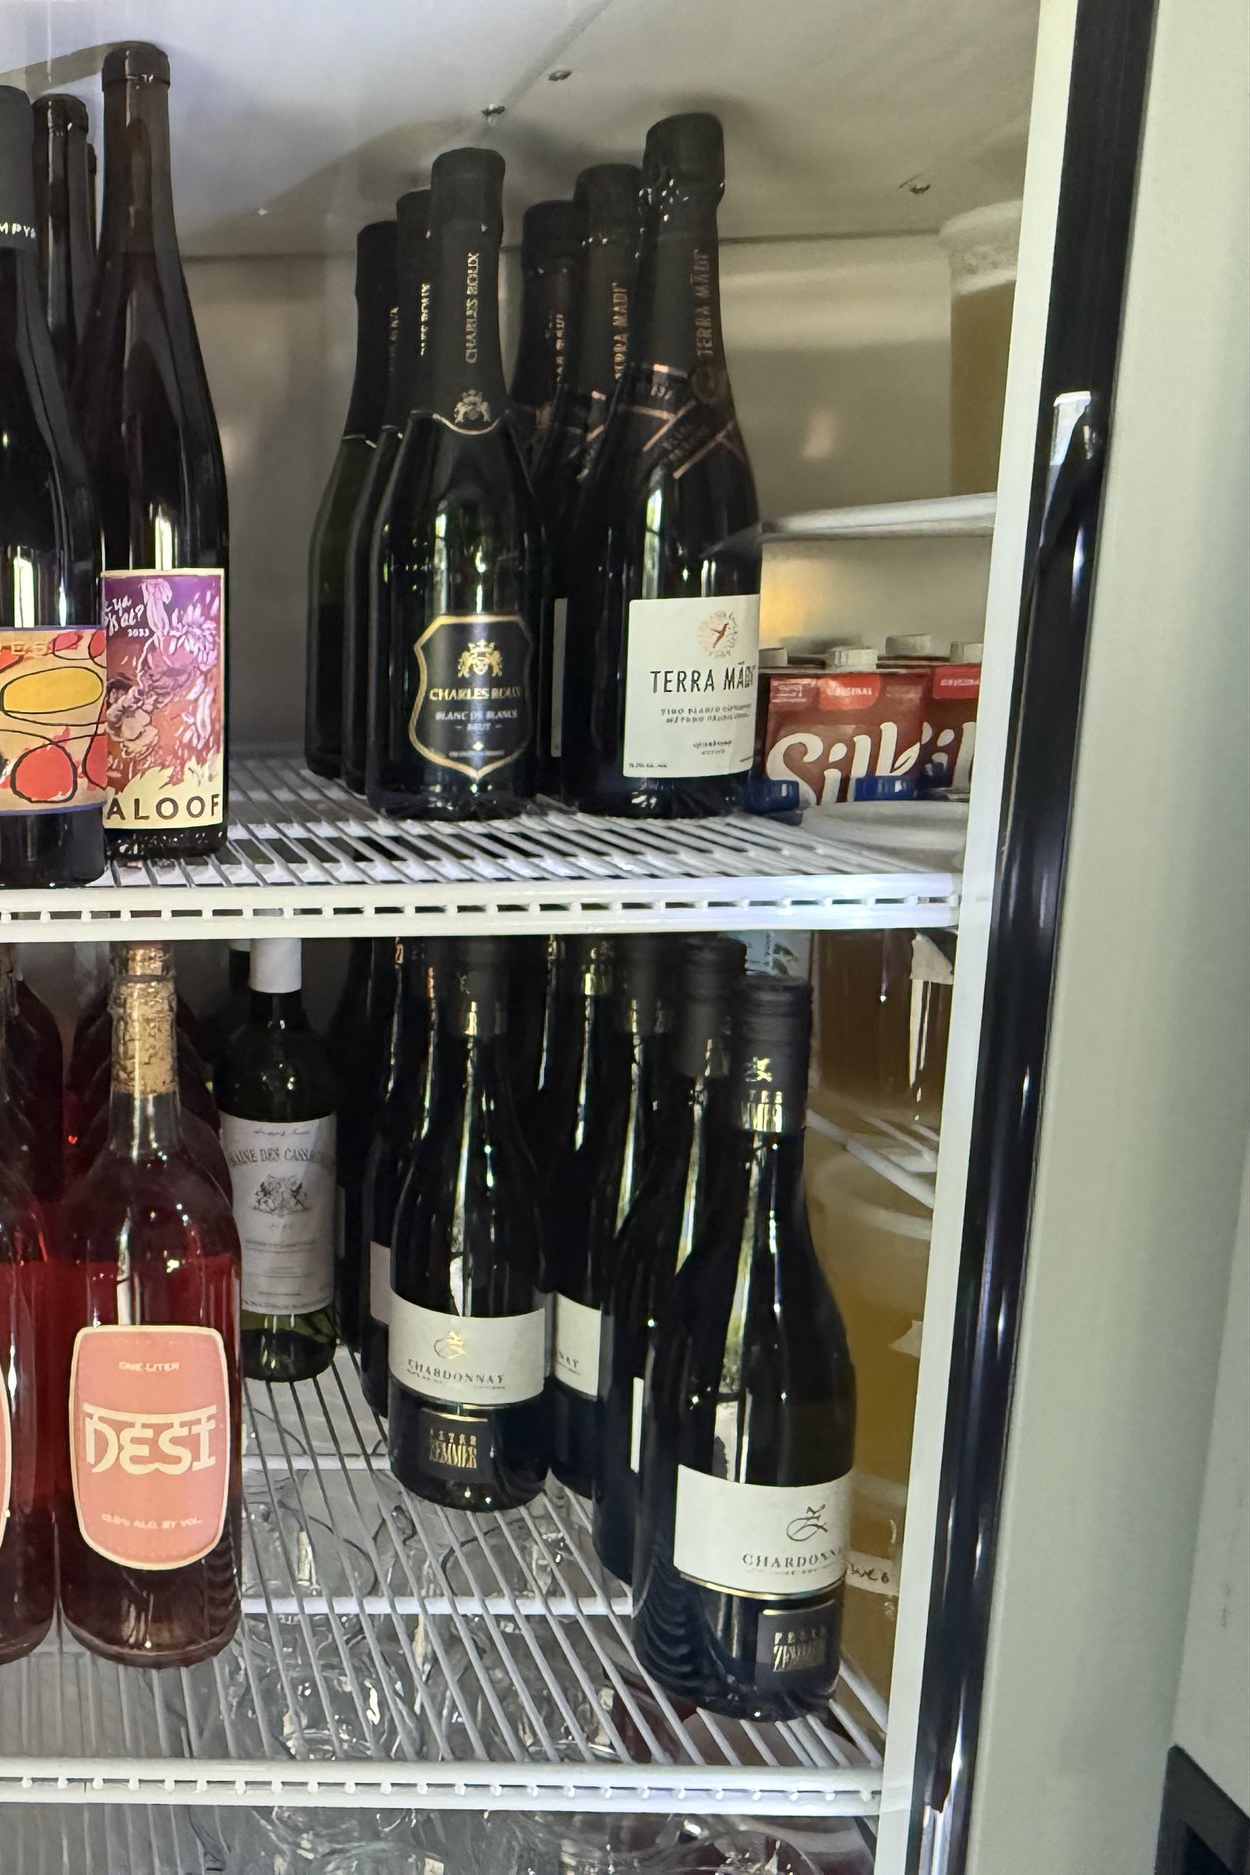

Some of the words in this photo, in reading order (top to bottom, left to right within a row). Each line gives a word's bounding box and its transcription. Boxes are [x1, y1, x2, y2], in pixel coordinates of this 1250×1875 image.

[429, 687, 490, 701] CHARLES
[649, 668, 716, 694] TERRA
[766, 721, 921, 806] Silk
[106, 793, 220, 821] ALOOF
[407, 1358, 505, 1385] CHARDONNAY
[82, 1402, 218, 1476] DESI
